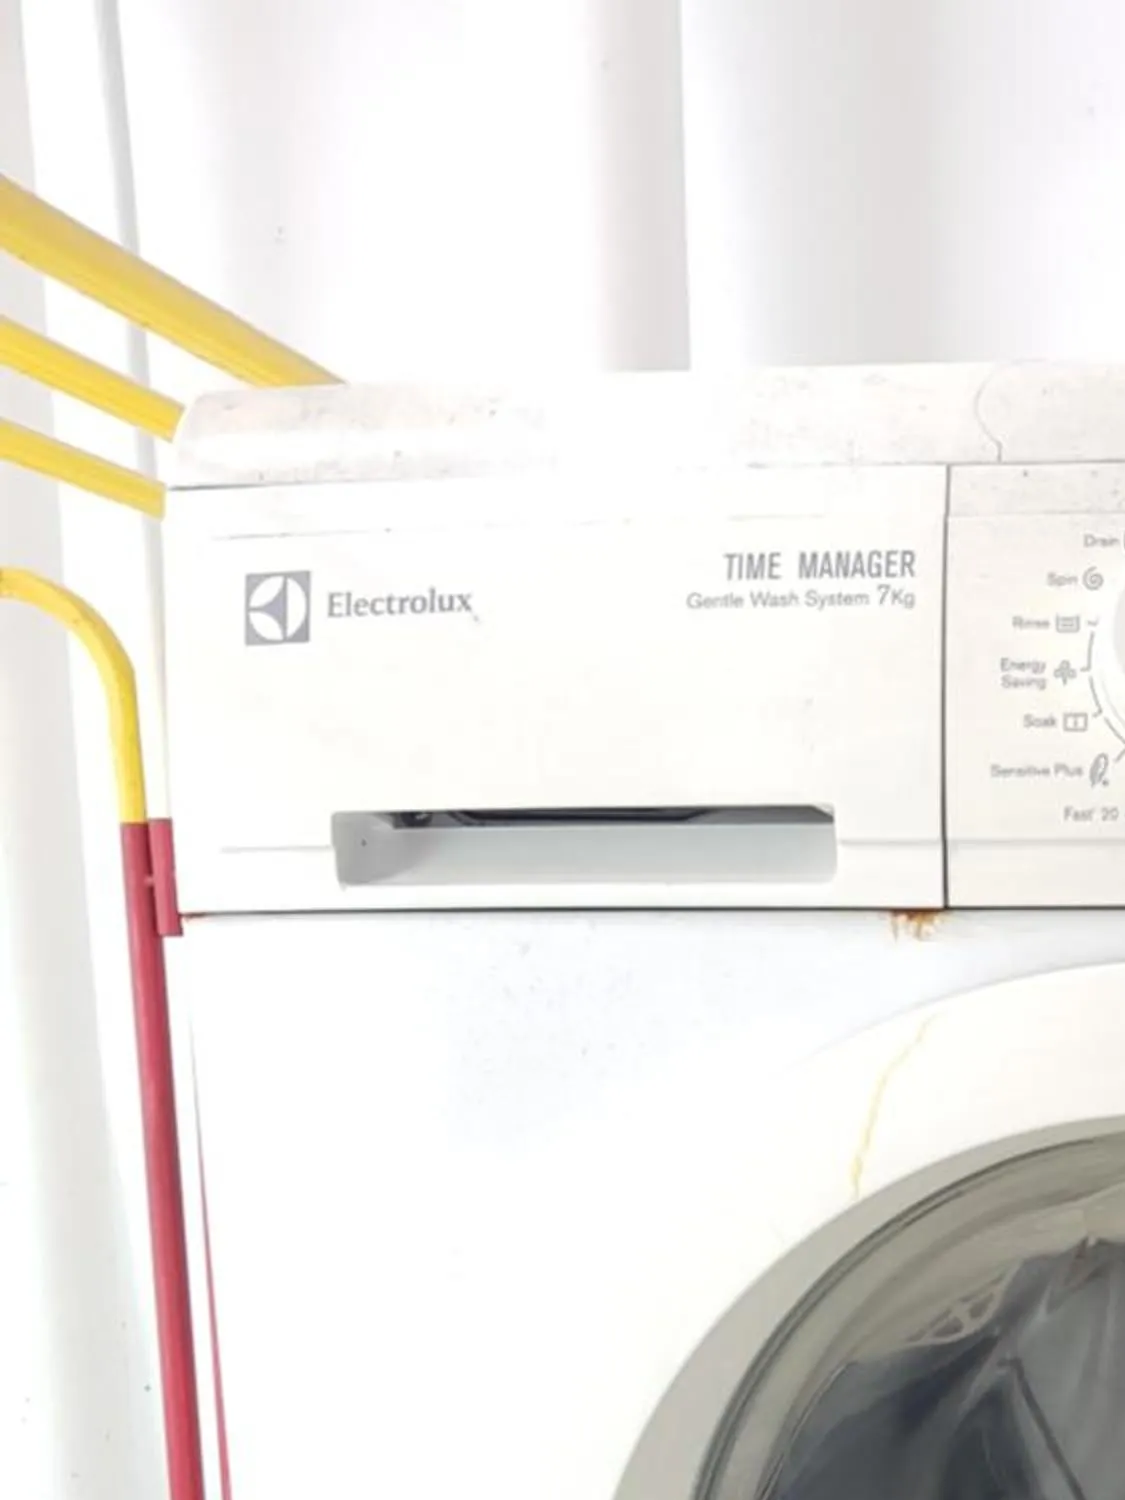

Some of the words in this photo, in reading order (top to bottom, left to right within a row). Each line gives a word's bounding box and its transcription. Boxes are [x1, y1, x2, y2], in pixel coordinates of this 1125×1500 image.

[1083, 534, 1119, 548] Drain
[723, 552, 782, 581] TIME
[798, 549, 916, 580] MANAGER
[1047, 572, 1077, 588] Spin
[327, 586, 474, 619] Electrolux
[686, 591, 744, 610] Gentle
[749, 590, 799, 608] Wash
[804, 588, 870, 611] System
[877, 583, 916, 610] 7Kg
[1012, 616, 1050, 630] Rinse
[1000, 658, 1046, 675] Energy
[1001, 675, 1047, 691] Saving
[1023, 714, 1056, 728] Soak
[990, 763, 1051, 778] Sensitive
[1054, 762, 1084, 778] Plus
[1101, 805, 1119, 821] 20
